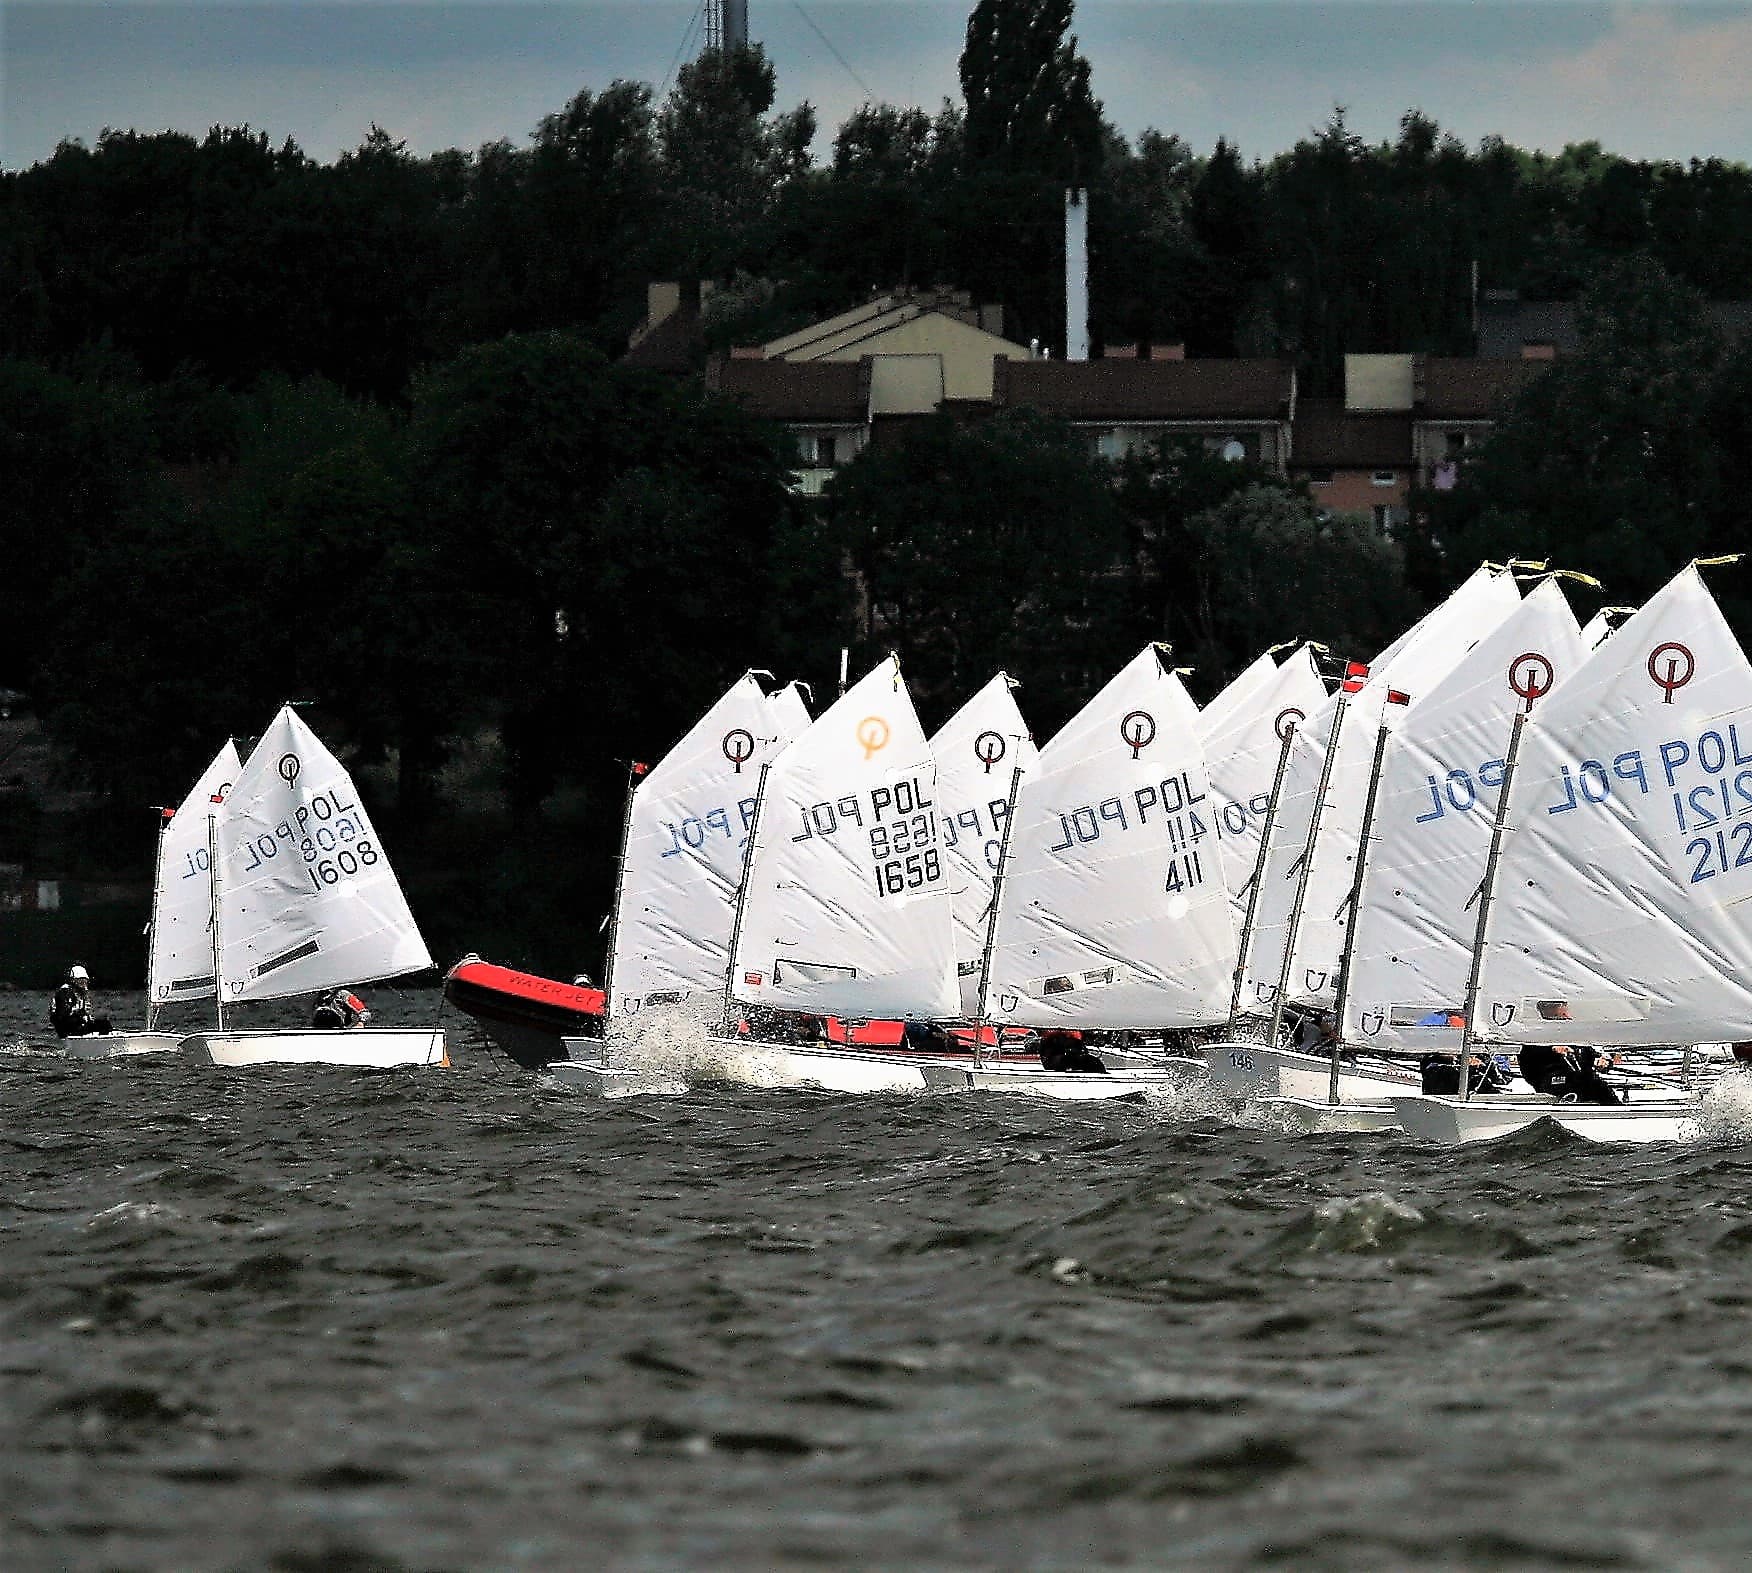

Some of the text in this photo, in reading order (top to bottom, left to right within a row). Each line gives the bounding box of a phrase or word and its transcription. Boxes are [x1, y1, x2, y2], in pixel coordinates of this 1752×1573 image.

[294, 790, 354, 835] POL
[870, 778, 932, 822] POL
[1135, 772, 1206, 824] POL
[308, 840, 378, 891] 1608
[875, 849, 940, 897] 1658
[1165, 850, 1203, 893] 411
